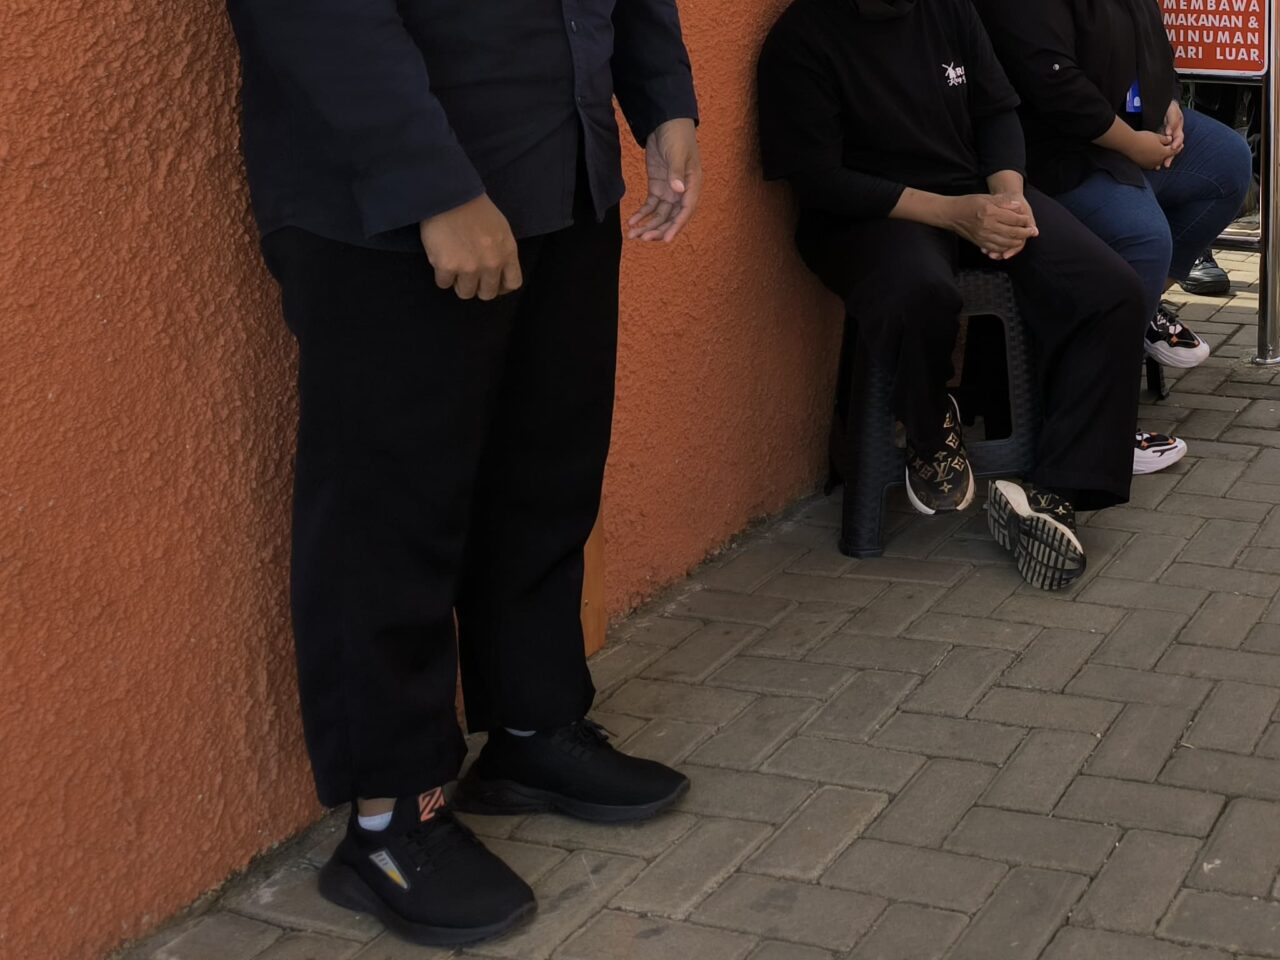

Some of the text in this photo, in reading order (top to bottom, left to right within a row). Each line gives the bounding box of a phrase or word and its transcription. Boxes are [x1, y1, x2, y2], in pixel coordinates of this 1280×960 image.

[1163, 12, 1260, 29] MAKANAN &
[1174, 45, 1260, 61] ARI LUAR
